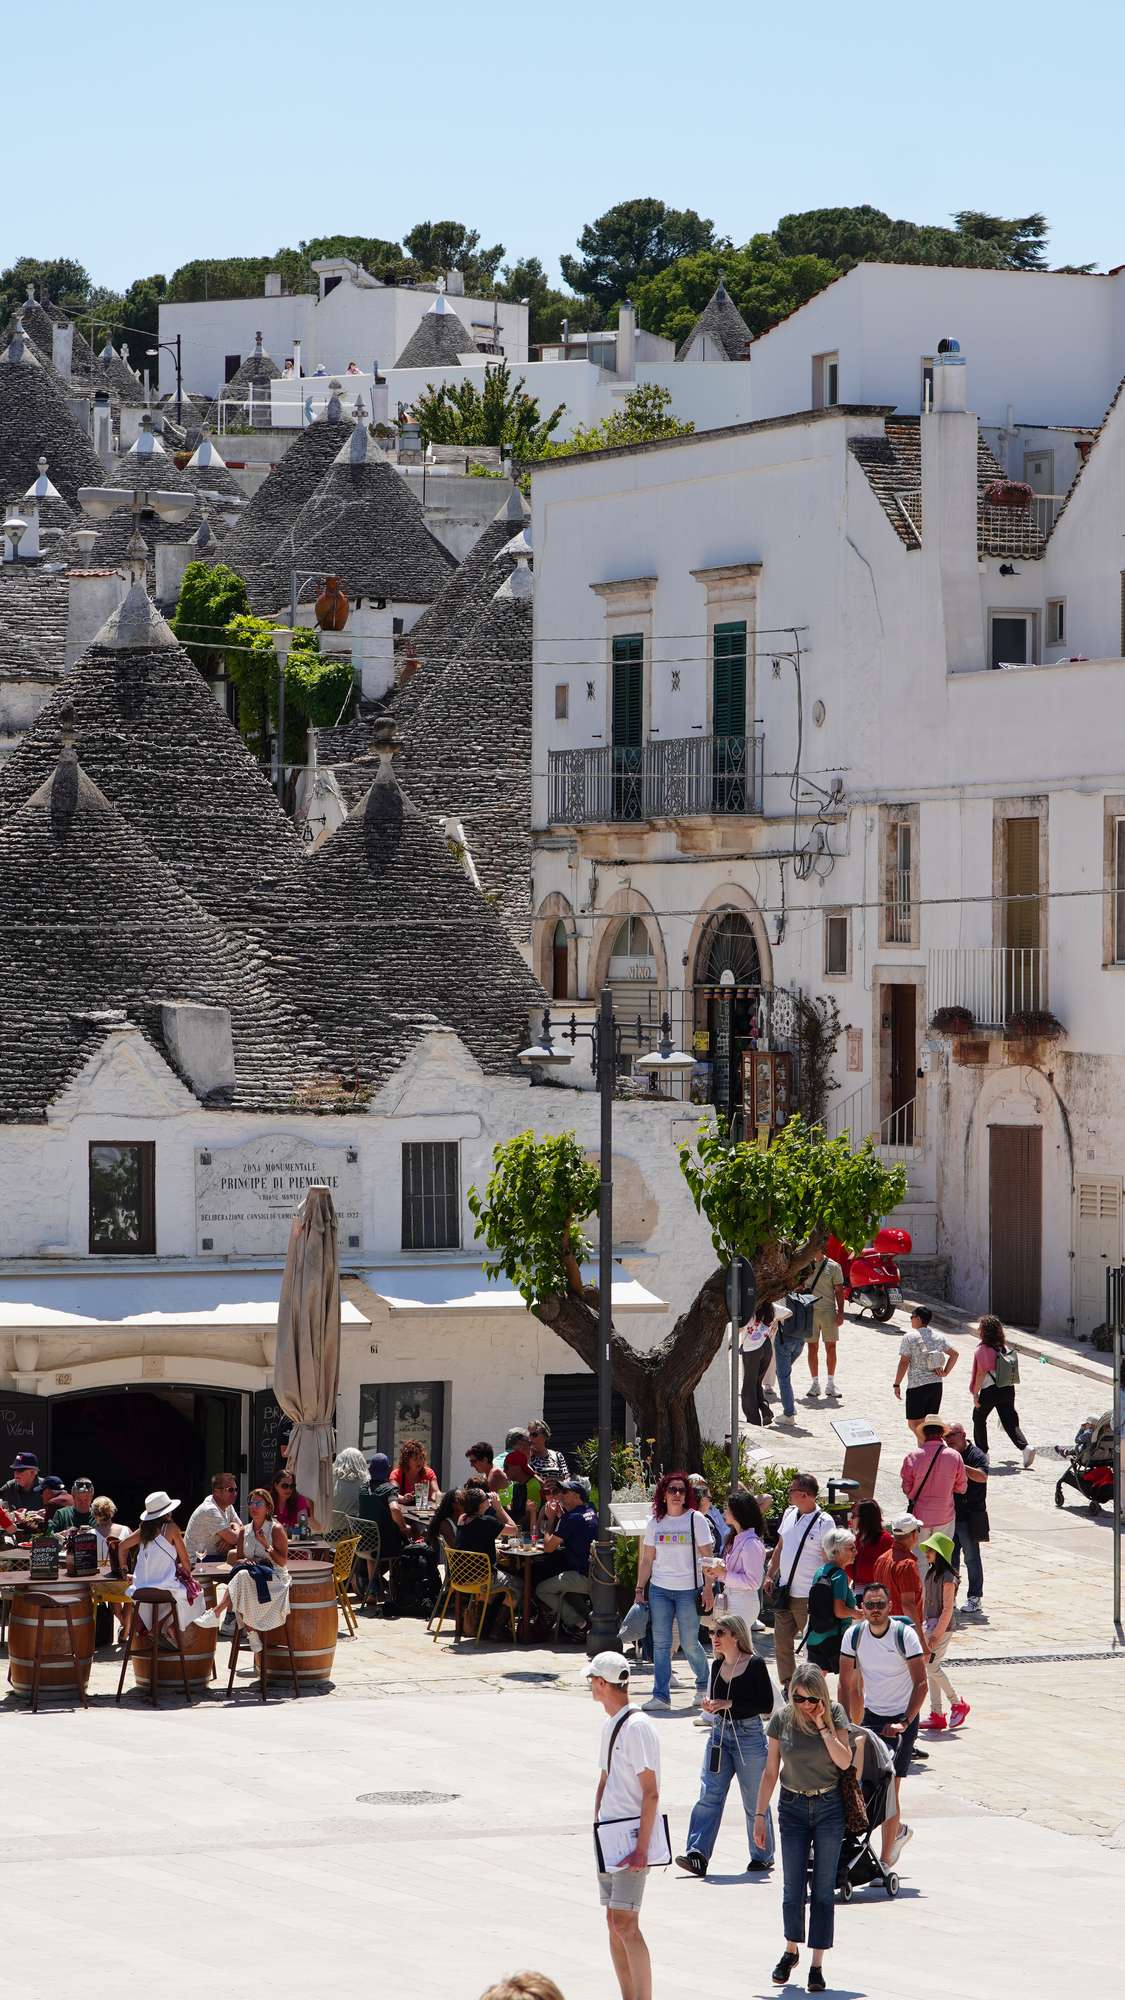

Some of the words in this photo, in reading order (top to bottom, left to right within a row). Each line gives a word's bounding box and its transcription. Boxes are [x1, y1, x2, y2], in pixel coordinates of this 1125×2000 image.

[243, 1163, 261, 1172] ZONA
[265, 1162, 317, 1172] MONUMENTALE
[221, 1177, 267, 1190] PRINCIPE
[273, 1176, 283, 1189] DI
[289, 1175, 339, 1189] PIEMONTE
[201, 1212, 244, 1221] DELIBERAZIONE
[370, 1344, 378, 1354] 61
[57, 1374, 72, 1385] 62
